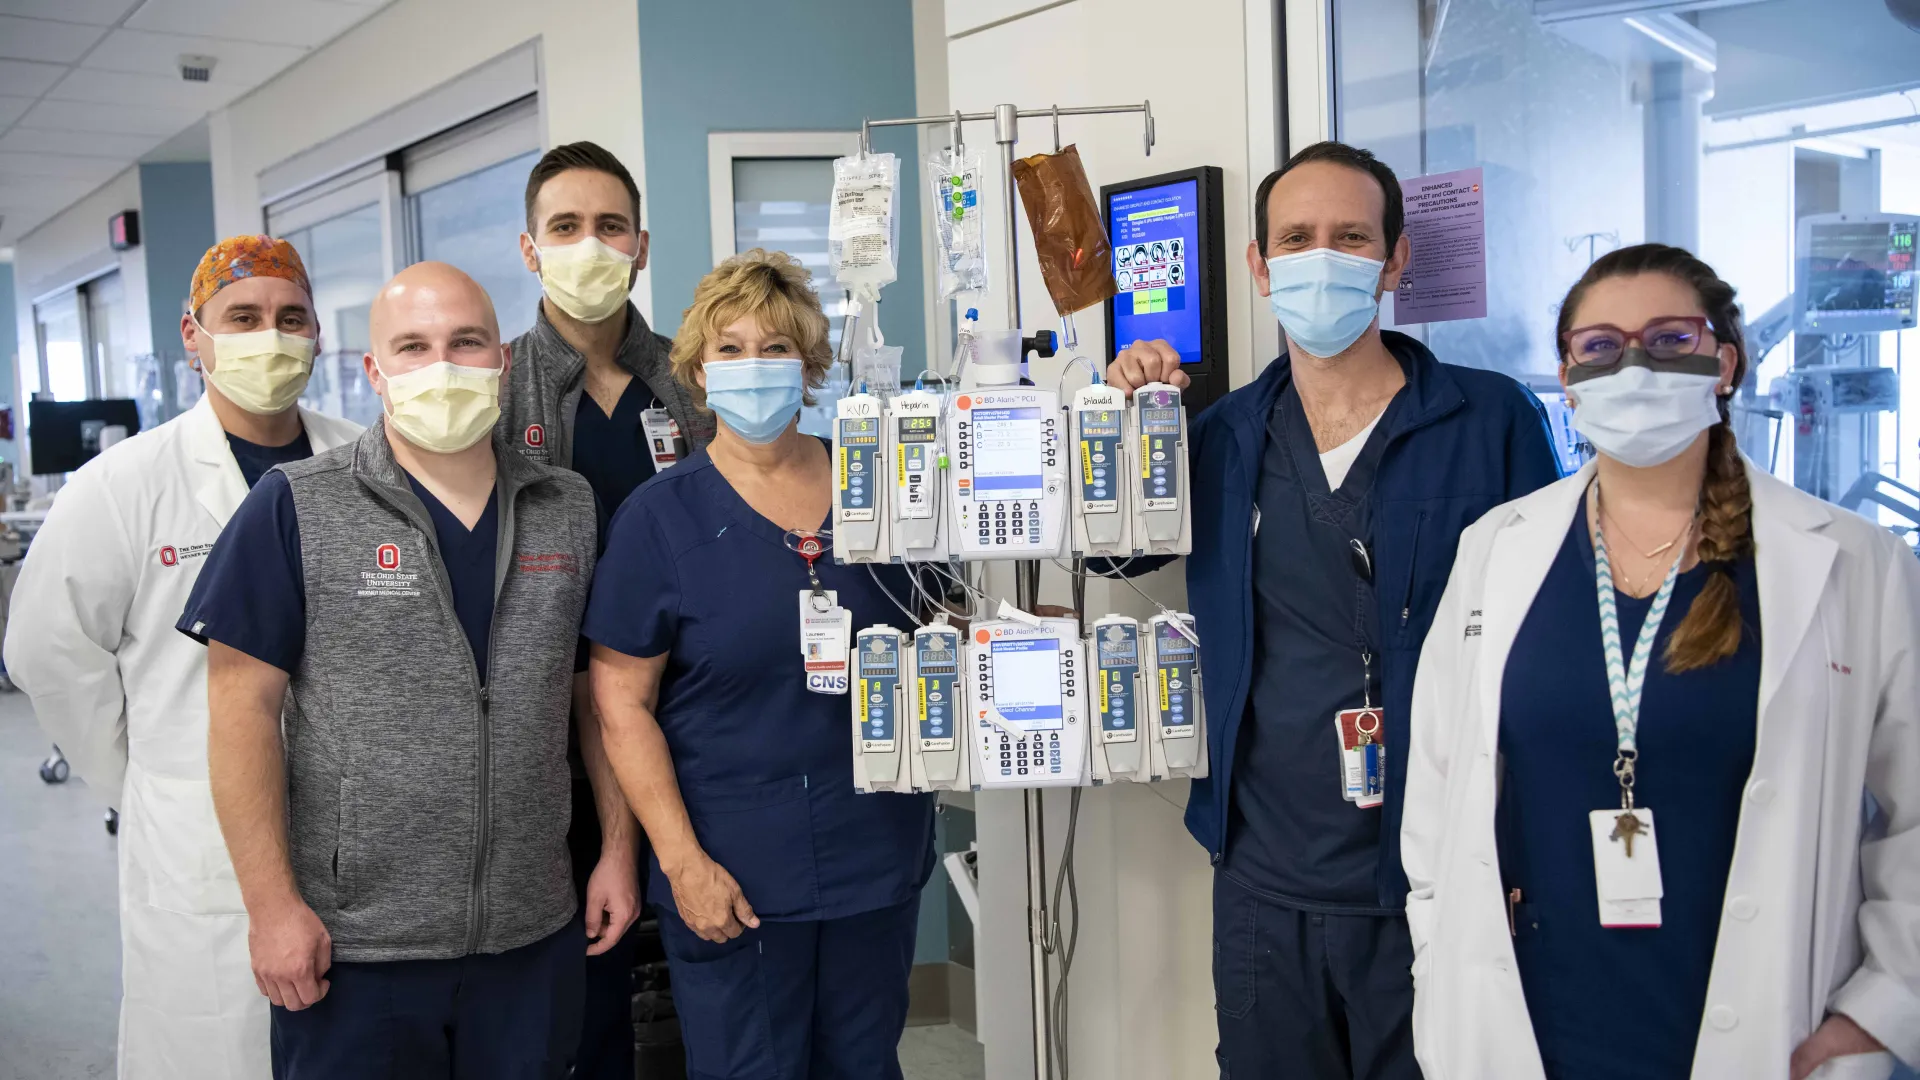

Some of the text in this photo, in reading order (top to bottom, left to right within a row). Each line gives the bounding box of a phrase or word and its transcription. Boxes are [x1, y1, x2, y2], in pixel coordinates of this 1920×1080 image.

[1422, 182, 1452, 192] ENHANCED
[1406, 194, 1430, 202] DROPLET
[1443, 187, 1470, 196] CONTACT
[1418, 197, 1458, 208] PRECAUTIONS
[1084, 396, 1112, 405] Dilaudid
[847, 404, 869, 416] KVO
[901, 401, 929, 411] Heparin
[1102, 412, 1108, 421] 6
[911, 419, 931, 428] 25.5
[810, 675, 847, 688] CNS
